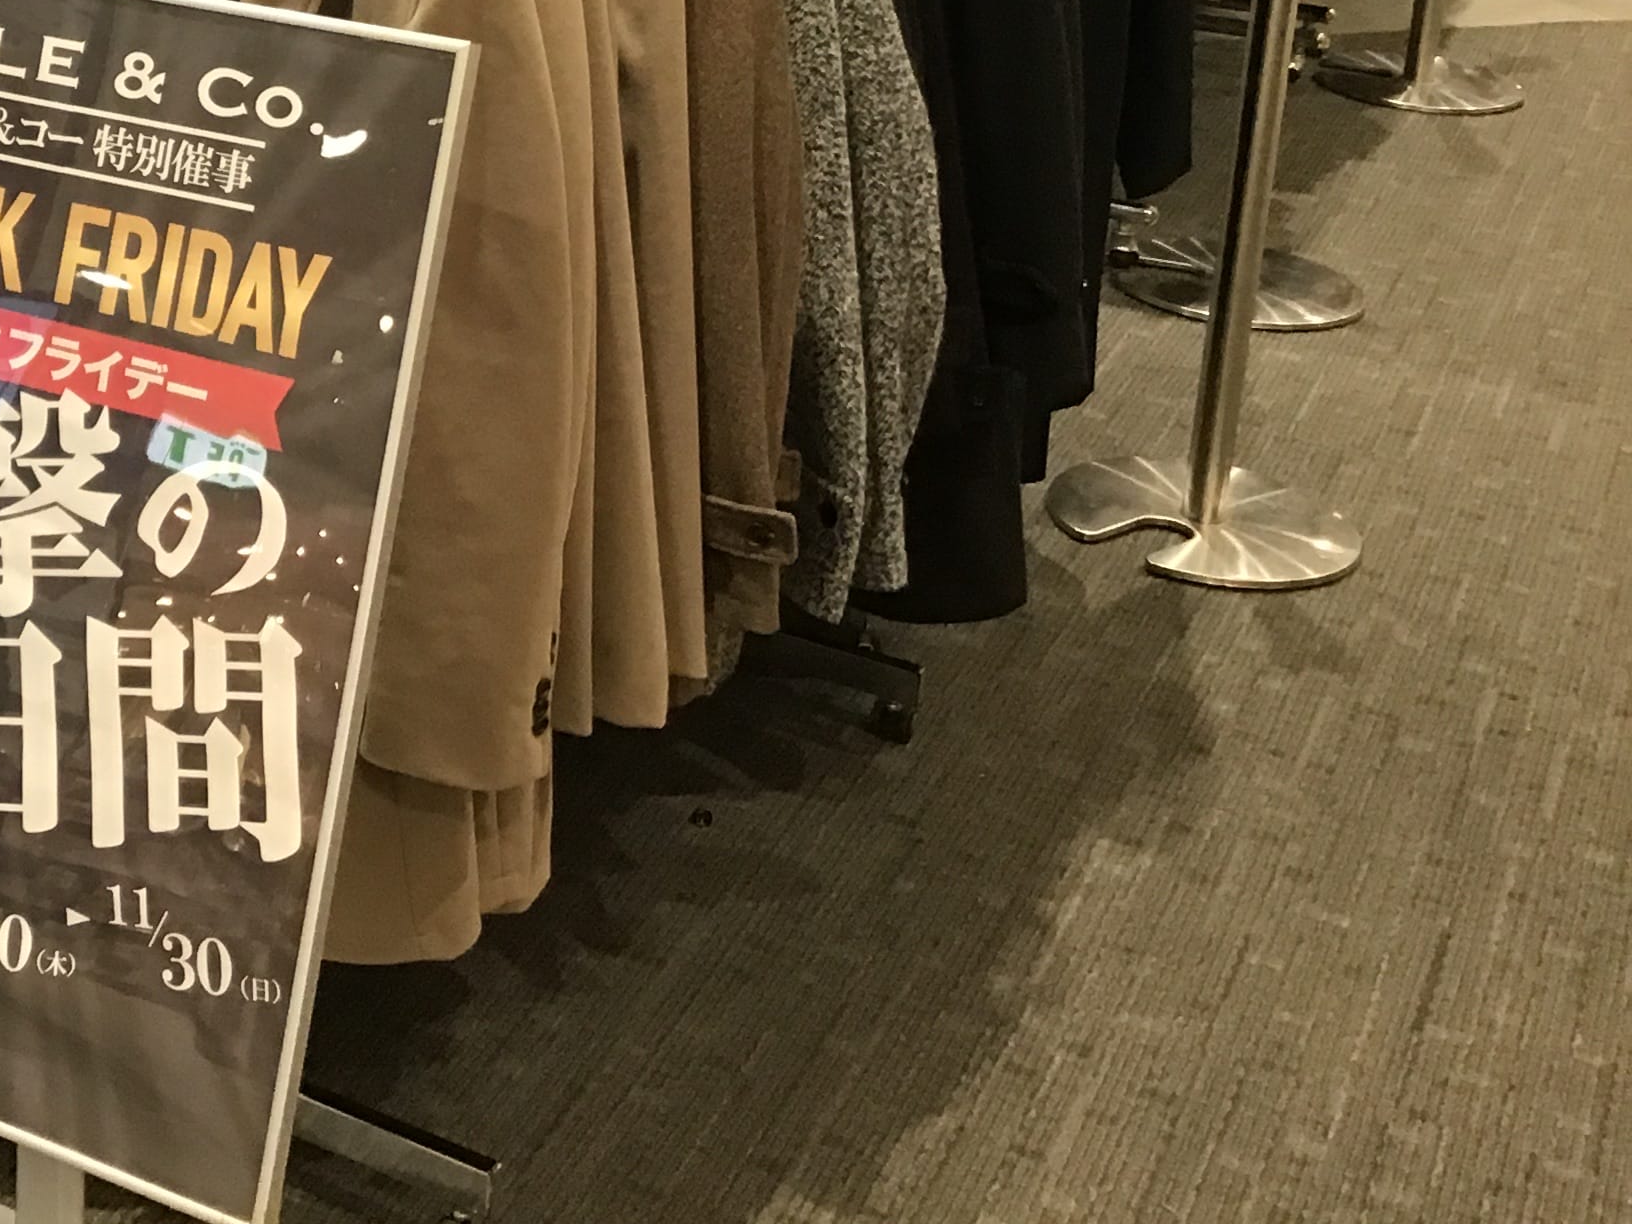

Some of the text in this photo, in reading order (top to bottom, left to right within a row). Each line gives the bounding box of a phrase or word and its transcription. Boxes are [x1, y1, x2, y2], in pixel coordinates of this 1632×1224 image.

[113, 50, 167, 107] &
[90, 121, 256, 195] 特別催事
[52, 202, 334, 361] FRIDAY
